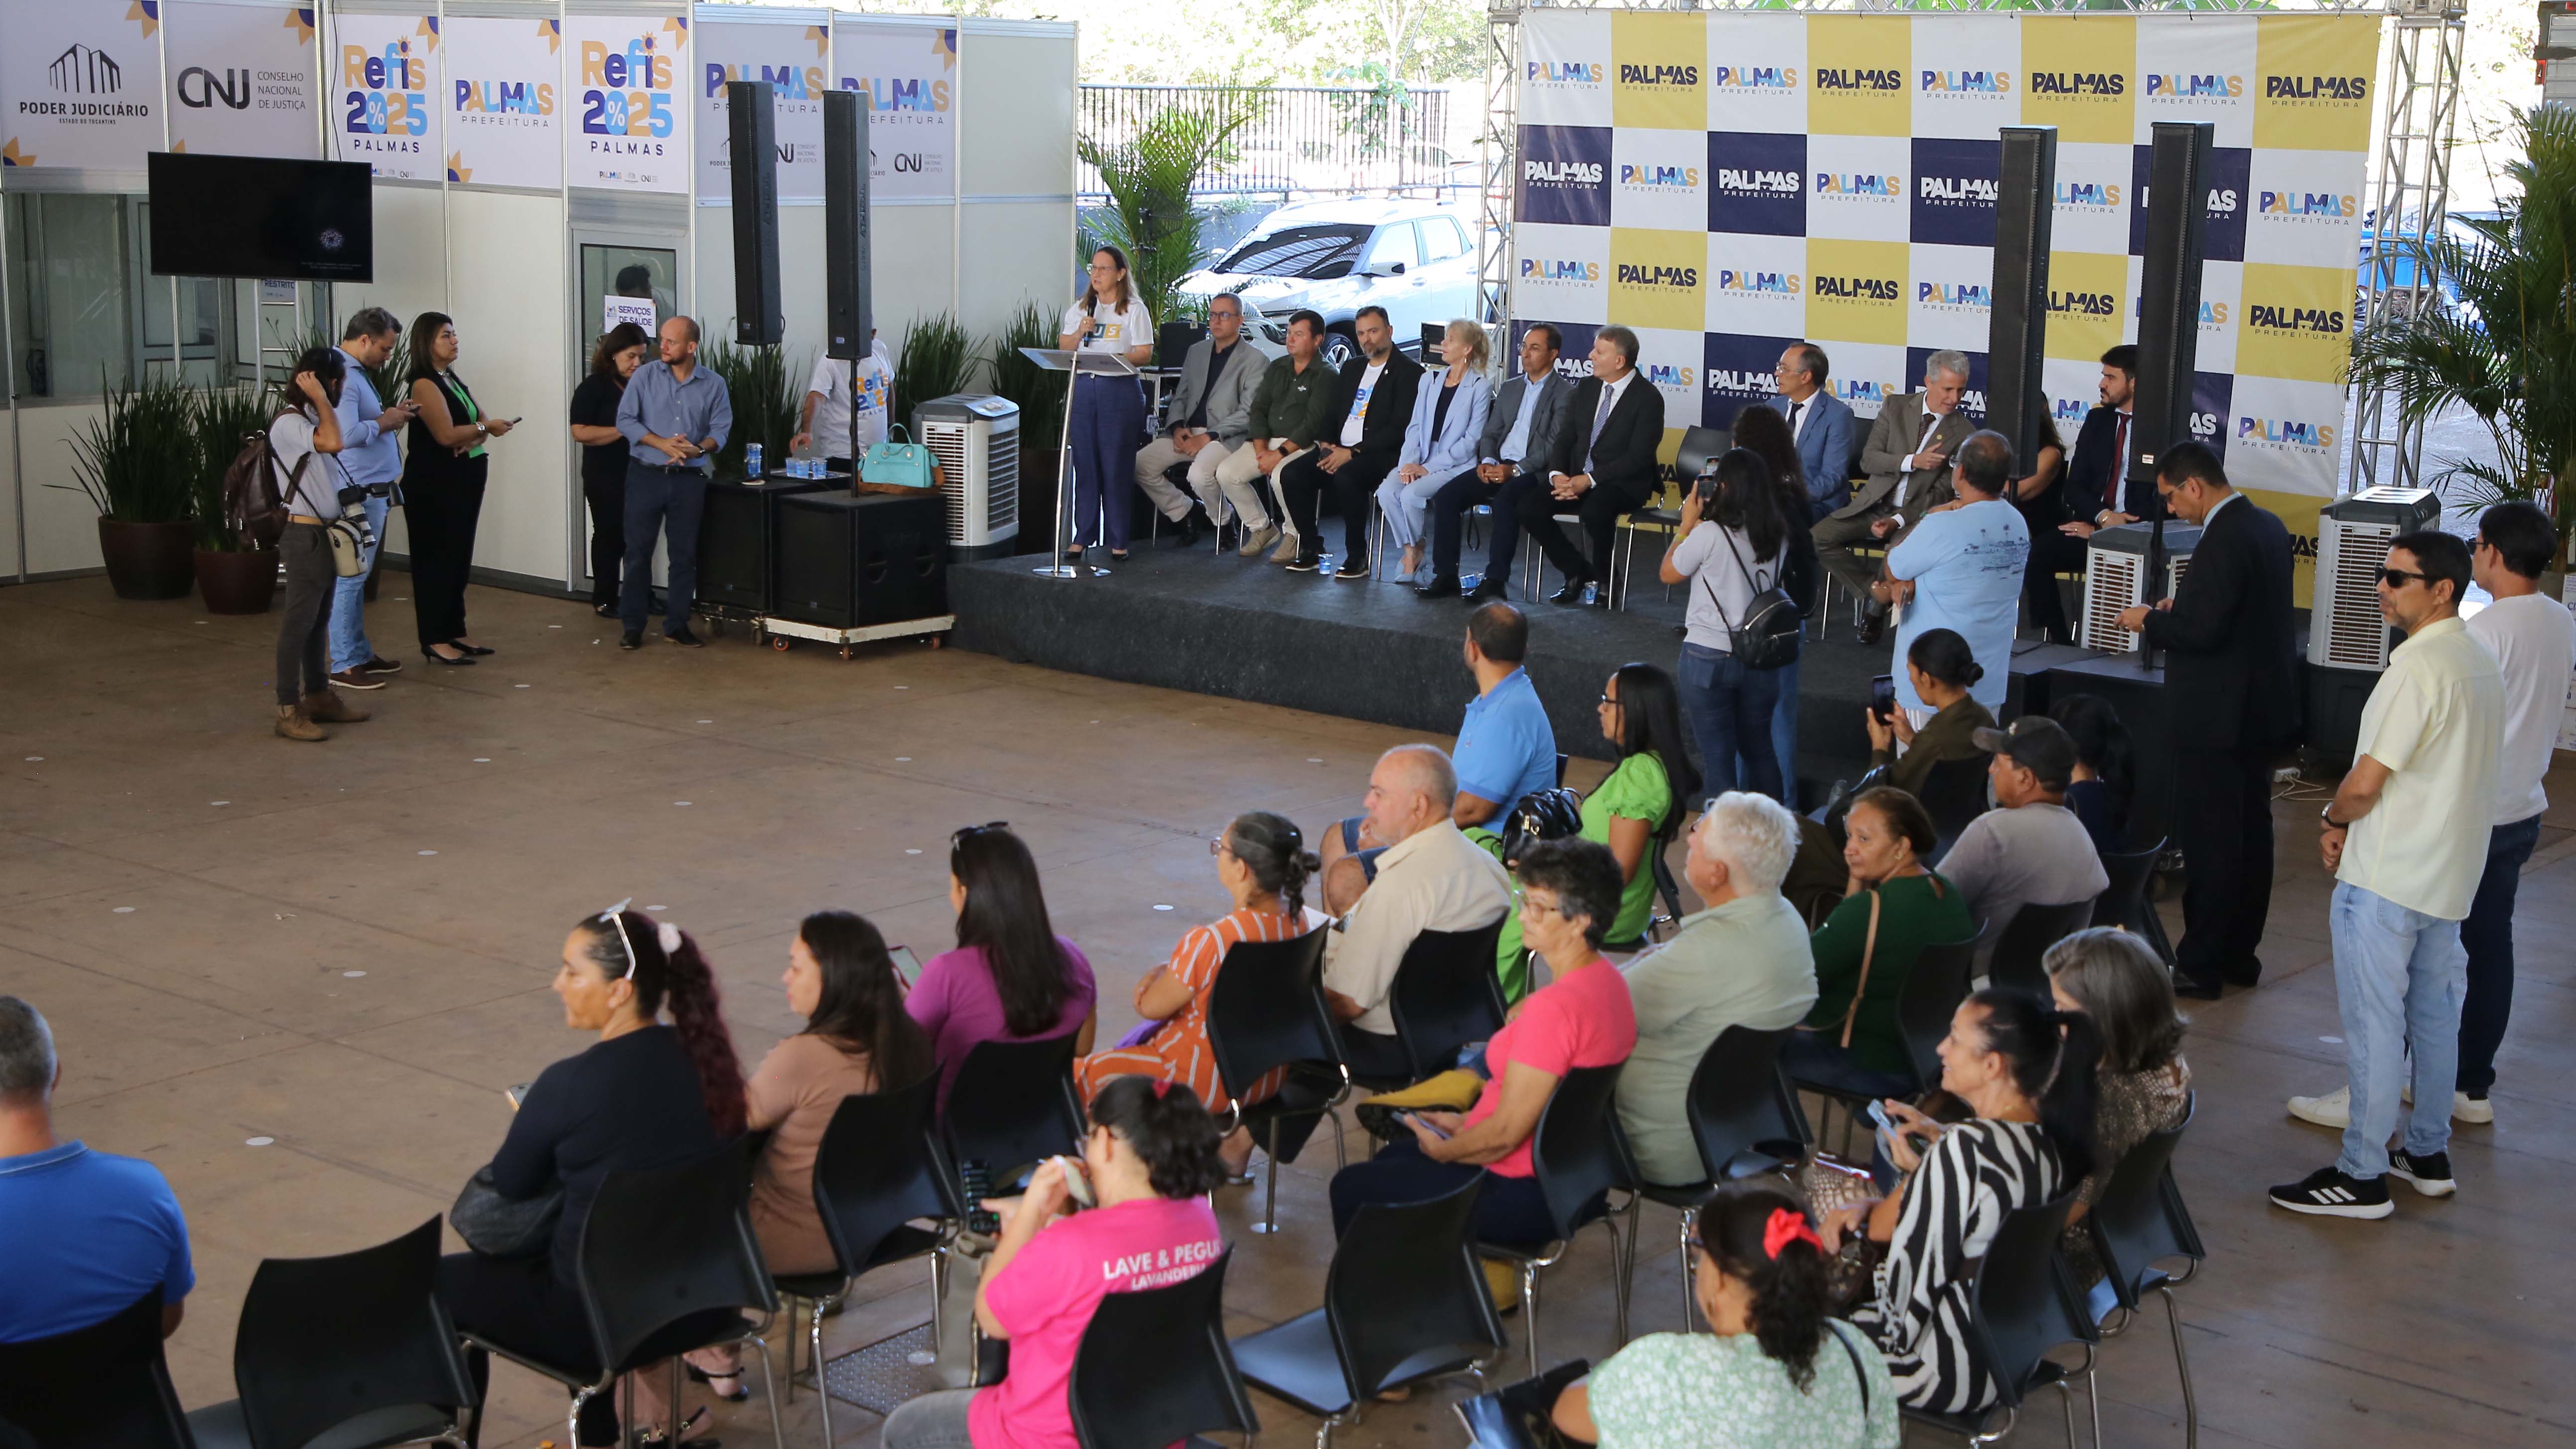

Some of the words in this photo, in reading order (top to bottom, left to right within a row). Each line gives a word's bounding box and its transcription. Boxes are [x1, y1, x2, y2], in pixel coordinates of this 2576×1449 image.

[343, 36, 426, 91] Refis
[581, 31, 673, 90] Refis
[258, 71, 303, 82] CONSELHO
[1528, 62, 1602, 82] PALMAS
[1621, 64, 1698, 85] PALMAS
[1717, 66, 1797, 88] PALMAS
[1817, 69, 1901, 90] PALMAS
[1922, 70, 2009, 93] PALMAS
[177, 67, 250, 110] CNJ
[258, 86, 302, 95] NACIONAL
[2032, 72, 2124, 95] PALMAS
[2147, 74, 2243, 98] PALMAS
[2267, 76, 2366, 100] PALMAS
[20, 102, 67, 115] PODER
[72, 101, 148, 117] JUDICIÁRIO
[259, 100, 270, 109] DE
[272, 100, 306, 111] JUSTIÇA
[456, 80, 554, 116] PALMAS
[462, 116, 549, 128] PREFEITURA
[354, 140, 420, 153] PALMAS
[591, 141, 664, 156] PALMAS
[775, 143, 794, 163] NJ
[894, 153, 922, 172] CNJ
[1525, 160, 1603, 183] PALMAS
[1621, 164, 1698, 187] PALMAS
[1718, 169, 1800, 193] PALMAS
[1817, 173, 1900, 196] PALMAS
[1724, 191, 1794, 199] PREFEITURA
[2052, 183, 2121, 206] LMAS
[2259, 190, 2355, 217] PALMAS
[2052, 205, 2114, 214] EFEITURA
[2264, 216, 2349, 226] PREFEITURA
[1521, 259, 1599, 282] PALMAS
[1618, 264, 1697, 287] PALMAS
[1720, 270, 1800, 293] PALMAS
[1525, 279, 1595, 289] PREFEITURA
[1622, 285, 1692, 294] PREFEITURA
[1816, 276, 1898, 300] PALMAS
[1919, 283, 1991, 306] PALMA
[1724, 291, 1795, 301] PREFEITURA
[1820, 297, 1893, 307] PREFEITURA
[2046, 291, 2114, 315] LMAS
[1923, 304, 1990, 314] PREFEITUR
[2047, 313, 2108, 323] EFEITURA
[2250, 305, 2344, 333] PALMAS
[2255, 329, 2337, 341] PREFEITURA
[1708, 369, 1780, 393] PALMA
[1825, 378, 1895, 403] ALMAS
[1713, 390, 1776, 399] PREFEITUR
[2238, 417, 2334, 447] PALMAS
[2242, 441, 2326, 455] PREFEITURA
[1103, 1252, 1152, 1280] LAVE
[1158, 1249, 1169, 1269] &
